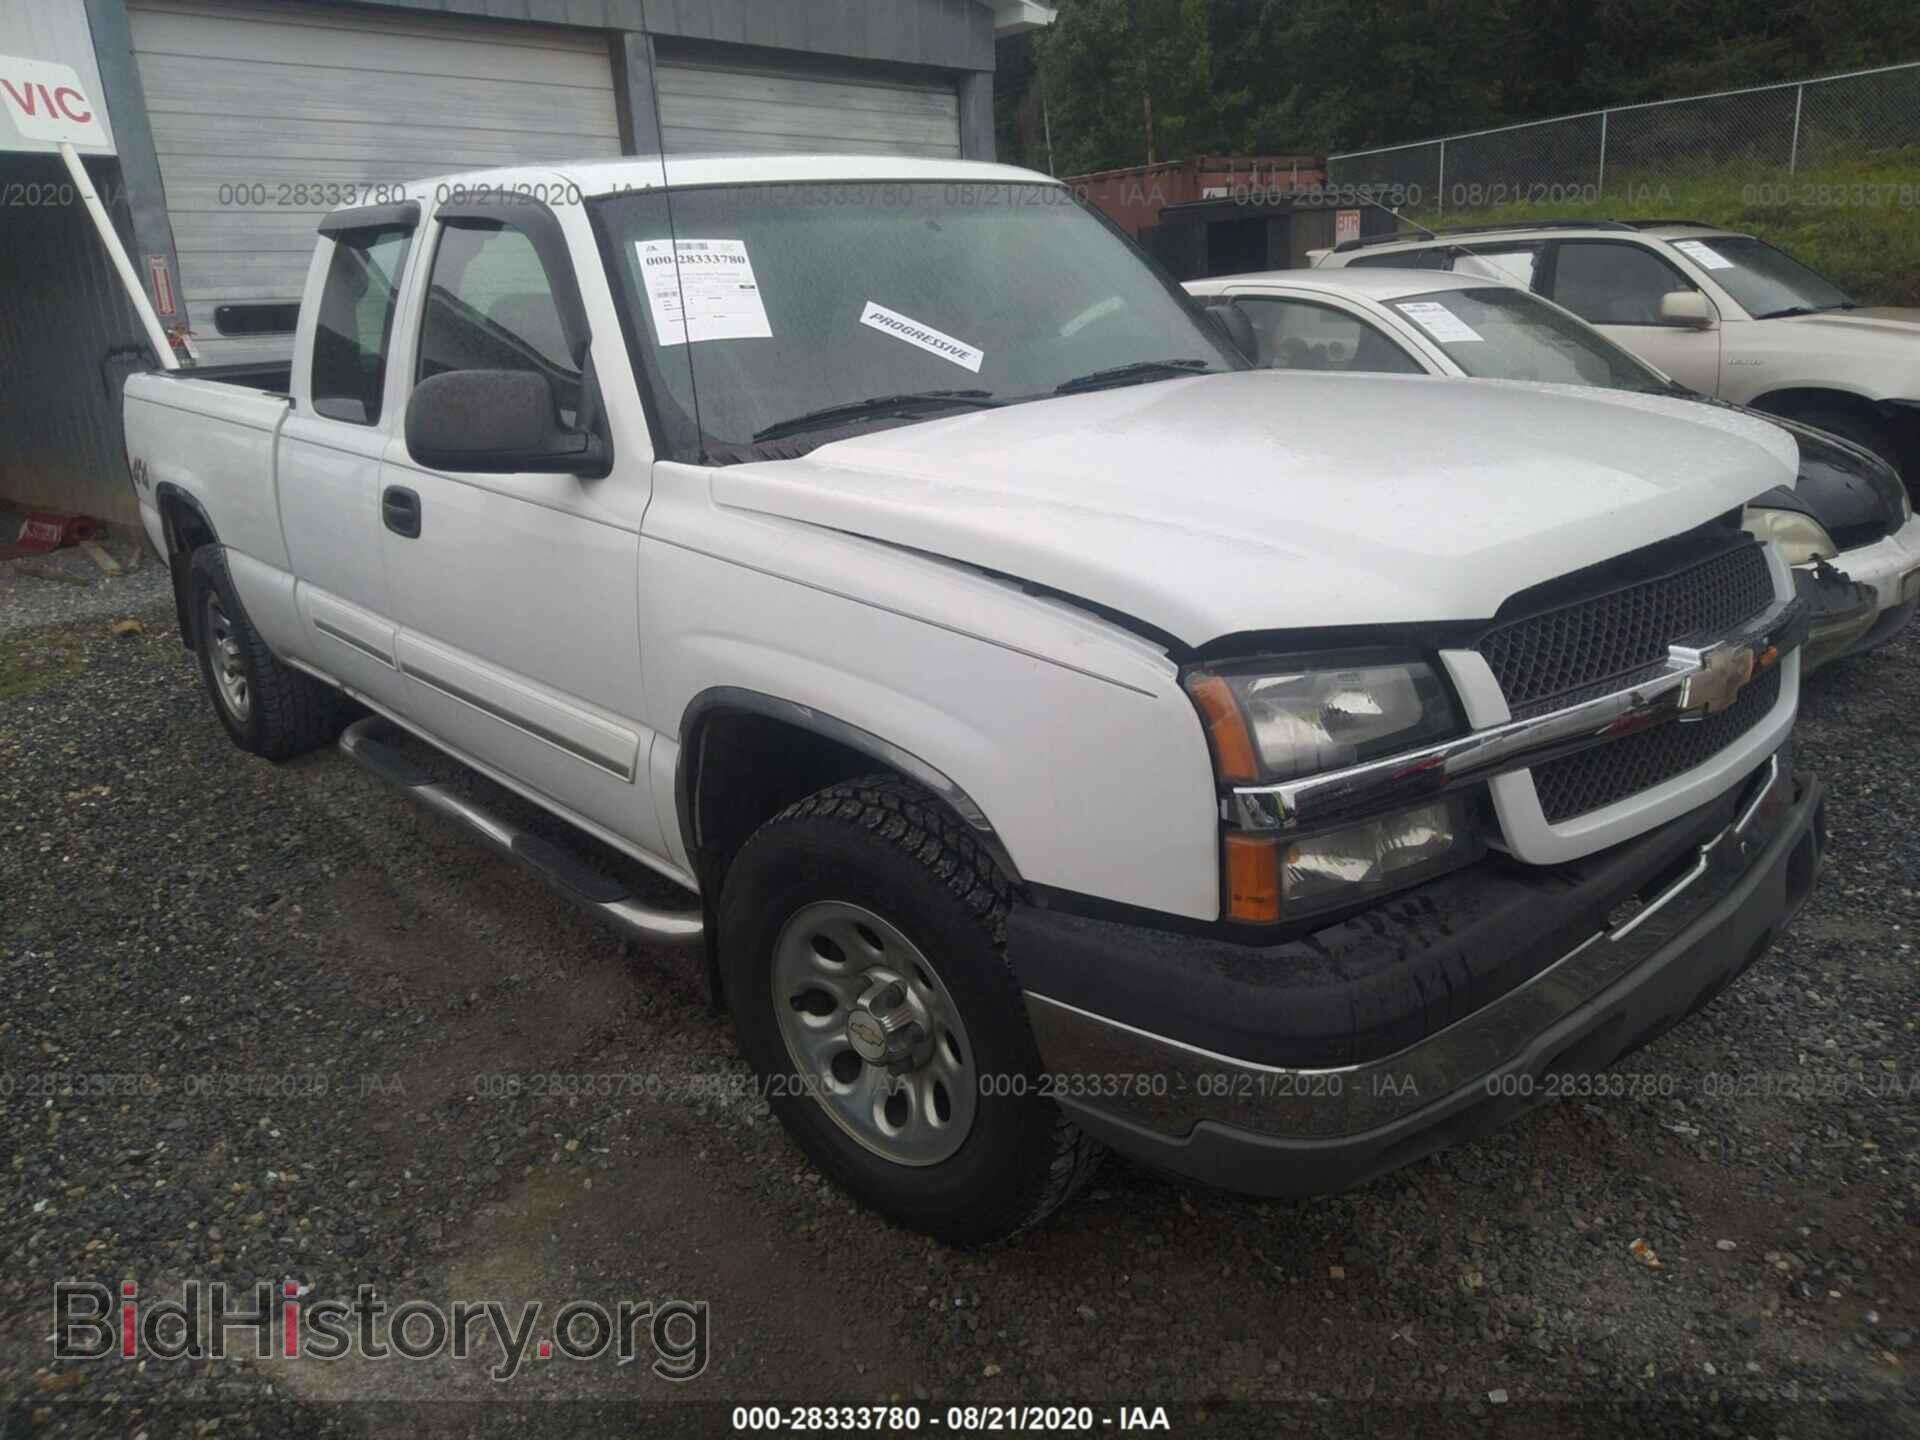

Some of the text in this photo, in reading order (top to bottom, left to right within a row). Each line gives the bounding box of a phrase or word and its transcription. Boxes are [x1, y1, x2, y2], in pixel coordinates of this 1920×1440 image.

[0, 78, 91, 123] VIC
[646, 254, 746, 266] 000-28333780
[869, 312, 972, 361] PROGRESSIVE
